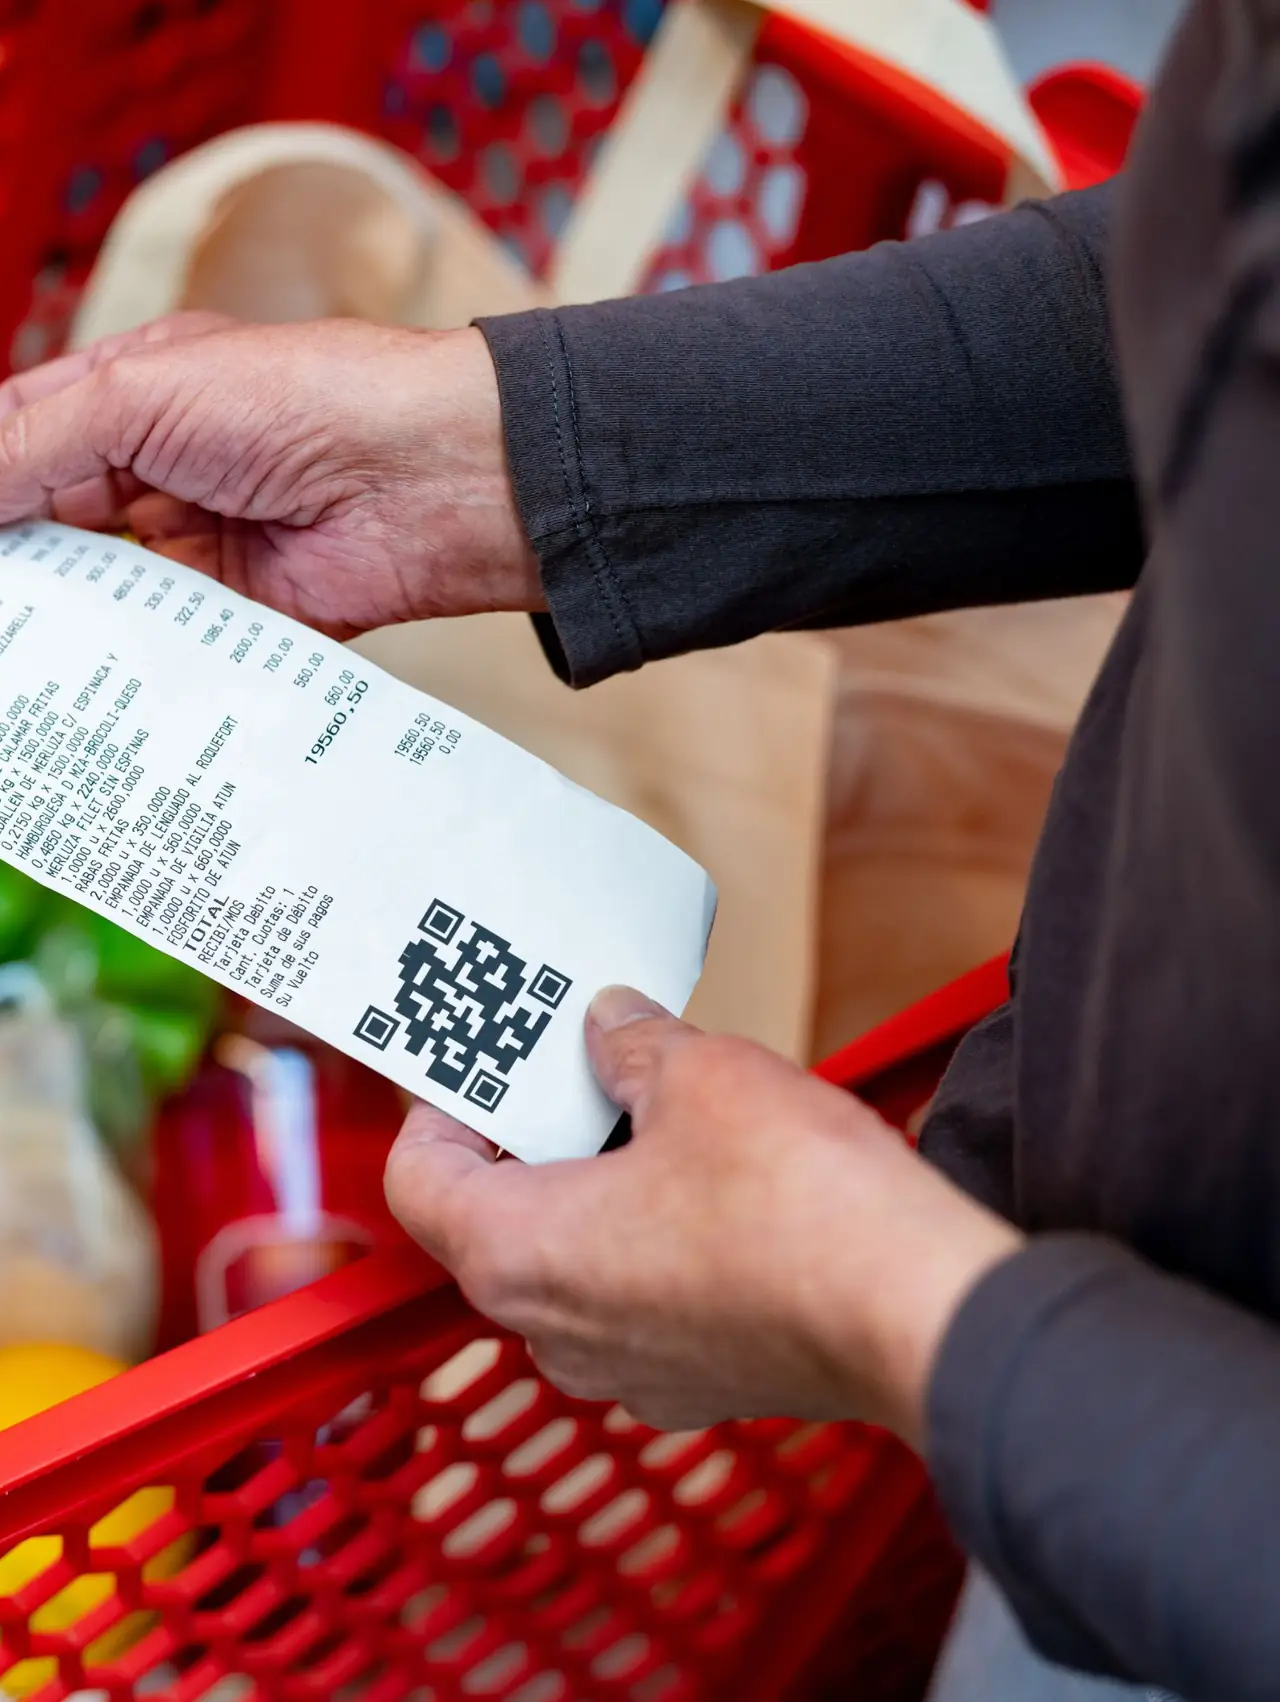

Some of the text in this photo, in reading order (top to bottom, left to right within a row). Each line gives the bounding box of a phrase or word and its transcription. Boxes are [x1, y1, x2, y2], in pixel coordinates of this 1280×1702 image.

[85, 552, 117, 583] 900,00
[112, 565, 146, 601] 4800,00
[143, 577, 175, 610] 330,00
[173, 591, 205, 626] 322,50
[200, 608, 234, 646] 1086,40
[228, 622, 264, 664] 2600,00
[262, 637, 294, 673] 700,00
[292, 652, 324, 688] 560,00
[323, 669, 355, 706] 660,00
[18, 774, 37, 791] DE
[30, 730, 66, 773] MERLUZA
[60, 712, 77, 728] C/
[72, 665, 111, 712] ESPINACA
[106, 652, 118, 661] Y
[27, 680, 60, 718] FRITAS
[304, 680, 368, 764] 19560,50
[393, 712, 431, 757] 19560,50
[10, 767, 21, 776] x
[16, 710, 59, 763] 1500,0000
[15, 678, 142, 860] HAMBURGUESA D MZA-BROCOLI-QUESO
[409, 720, 446, 765] 19560,50
[438, 728, 462, 755] 0,00
[0, 726, 89, 851] 0,2150 kg x 1500,0000
[30, 742, 119, 869] 0,4850 kg x 2240,0000
[45, 728, 149, 878] MERLUZA FILET SIN ESPINAS
[60, 764, 145, 883] 1,0000 u x 2600,0000
[104, 715, 238, 909] EMPANADA DE LENGUADO AL ROQUEFORT
[74, 818, 130, 893] RABAS FRITAS
[89, 785, 171, 901] 2,0000 u x 350,0000
[121, 802, 202, 916] 1,0000 u x 560,0000
[135, 781, 236, 928] EMPANADA DE VIGILIA ATUN
[152, 819, 232, 935] 1,0000 u x 660,0000
[166, 839, 241, 946] FOSFORITO DE ATUN
[182, 896, 230, 951] TOTAL
[212, 885, 276, 971] Tarjeta Debito
[197, 899, 245, 964] RECIBI/MOS
[228, 887, 295, 981] Cant. Cuotas: 1
[243, 885, 318, 988] Tarjeta de Débito
[259, 894, 334, 999] Suma de sus pagos
[275, 950, 319, 1008] Su Vuelto
